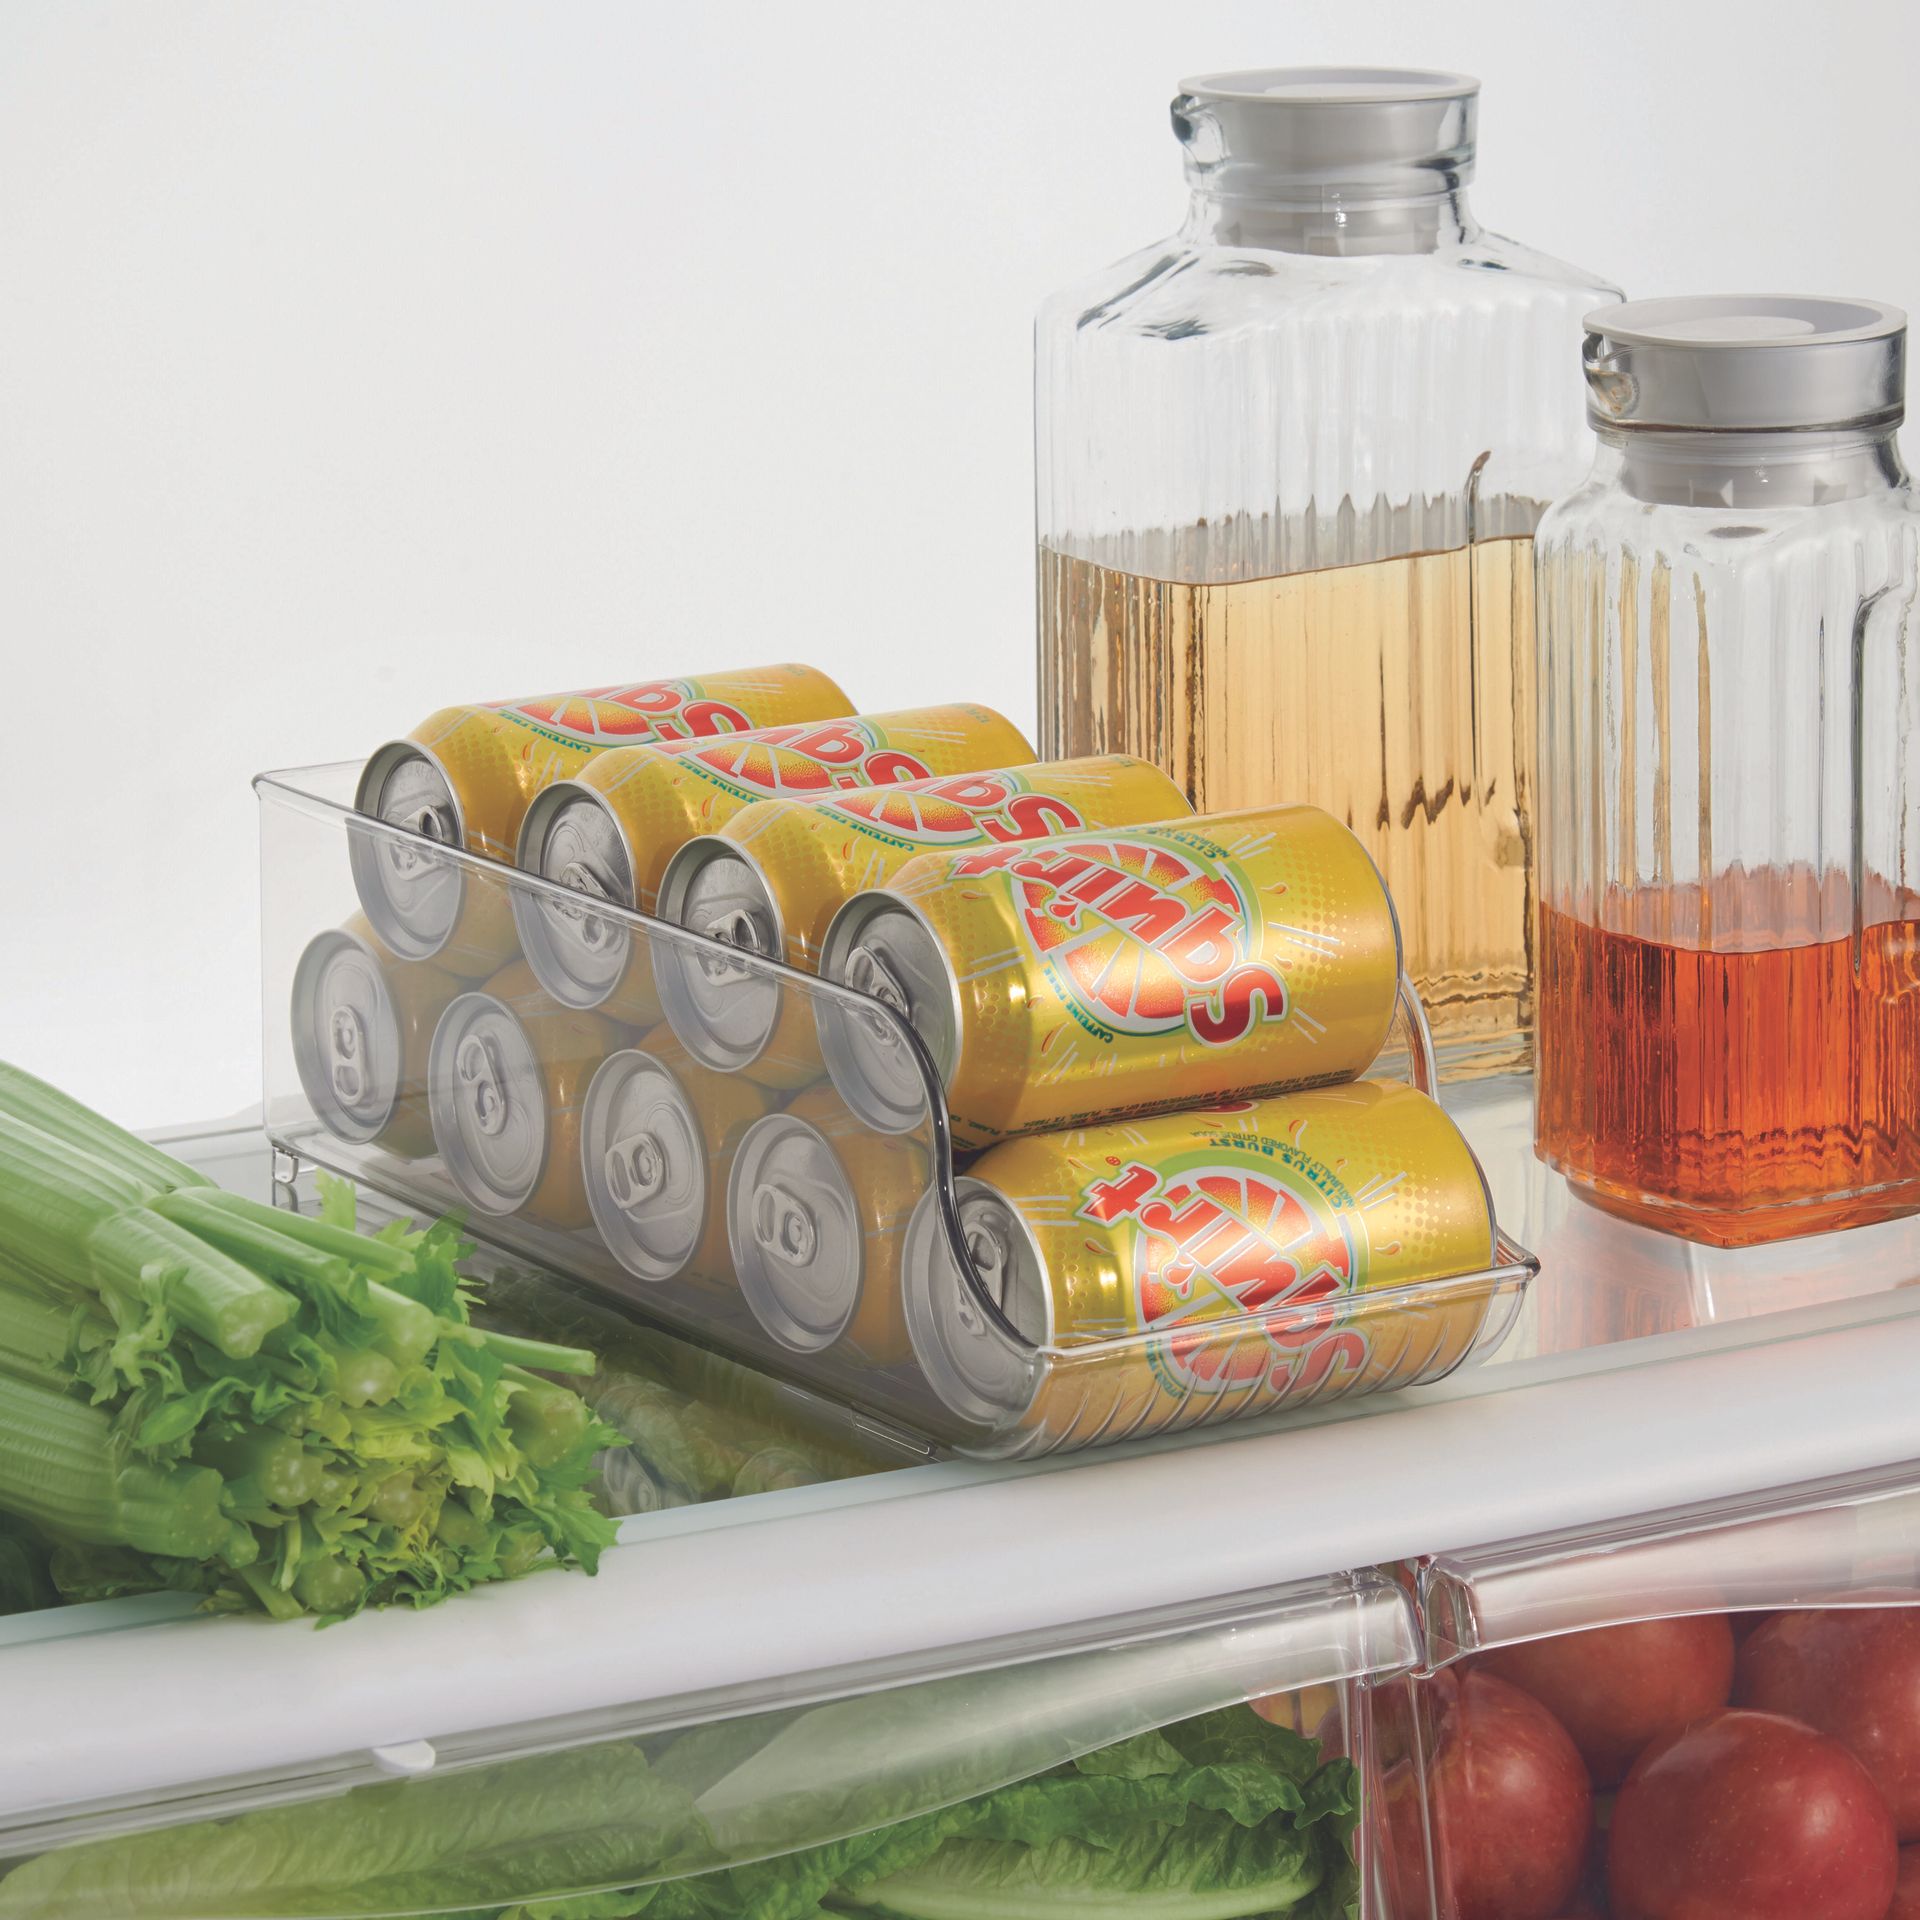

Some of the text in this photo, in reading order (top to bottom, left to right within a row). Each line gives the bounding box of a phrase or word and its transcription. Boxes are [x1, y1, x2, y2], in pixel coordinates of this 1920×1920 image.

[529, 725, 592, 754] CAFFEINE
[677, 760, 710, 781] FREE
[815, 807, 916, 853] CAFFEINE FREE
[949, 842, 1288, 1048] Squirt
[1043, 966, 1114, 1044] CAFFEINE FREE
[1209, 1137, 1343, 1210] CITRUS BURST
[1261, 1136, 1312, 1164] FLAVORED
[1313, 1160, 1355, 1208] NATURALLY
[1080, 1163, 1367, 1394] Squirt
